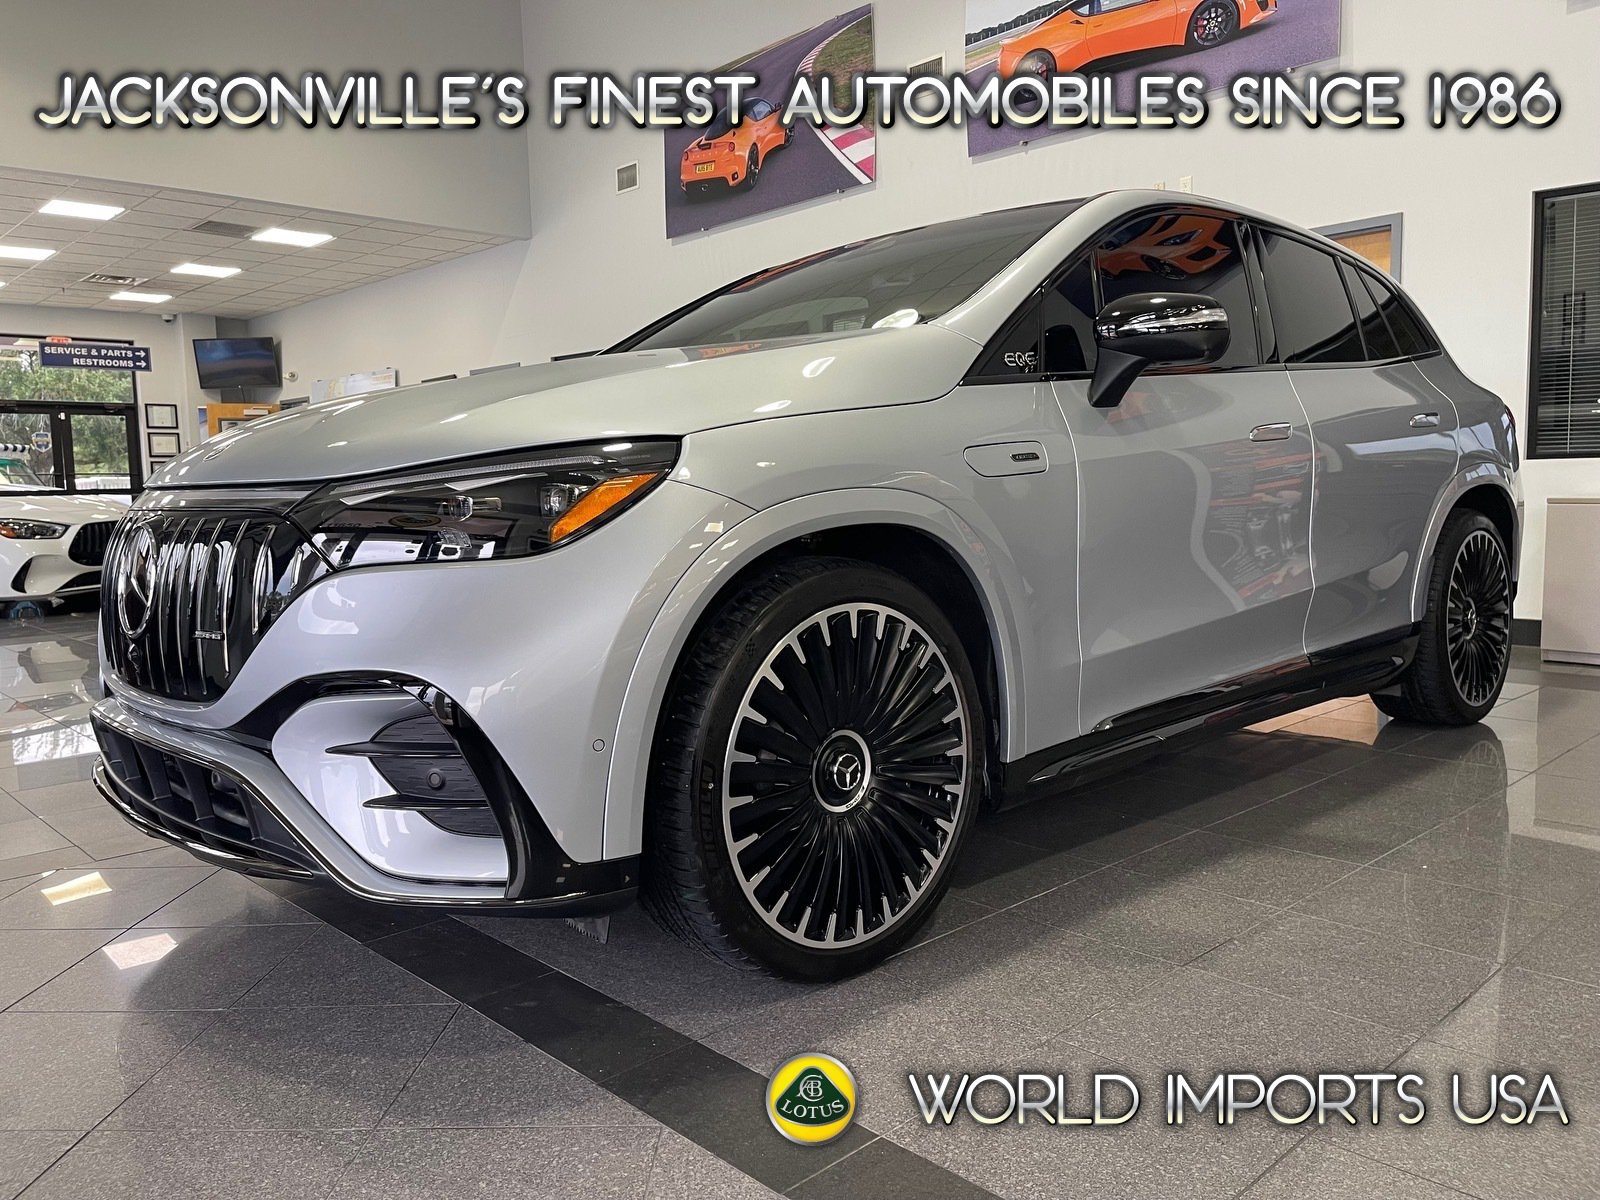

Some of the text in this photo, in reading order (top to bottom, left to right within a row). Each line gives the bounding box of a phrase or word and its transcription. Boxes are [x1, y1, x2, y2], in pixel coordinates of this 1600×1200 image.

[44, 347, 133, 357] SERVICE & PARTS
[73, 358, 134, 367] RESTROOMS
[1004, 351, 1036, 367] EQE
